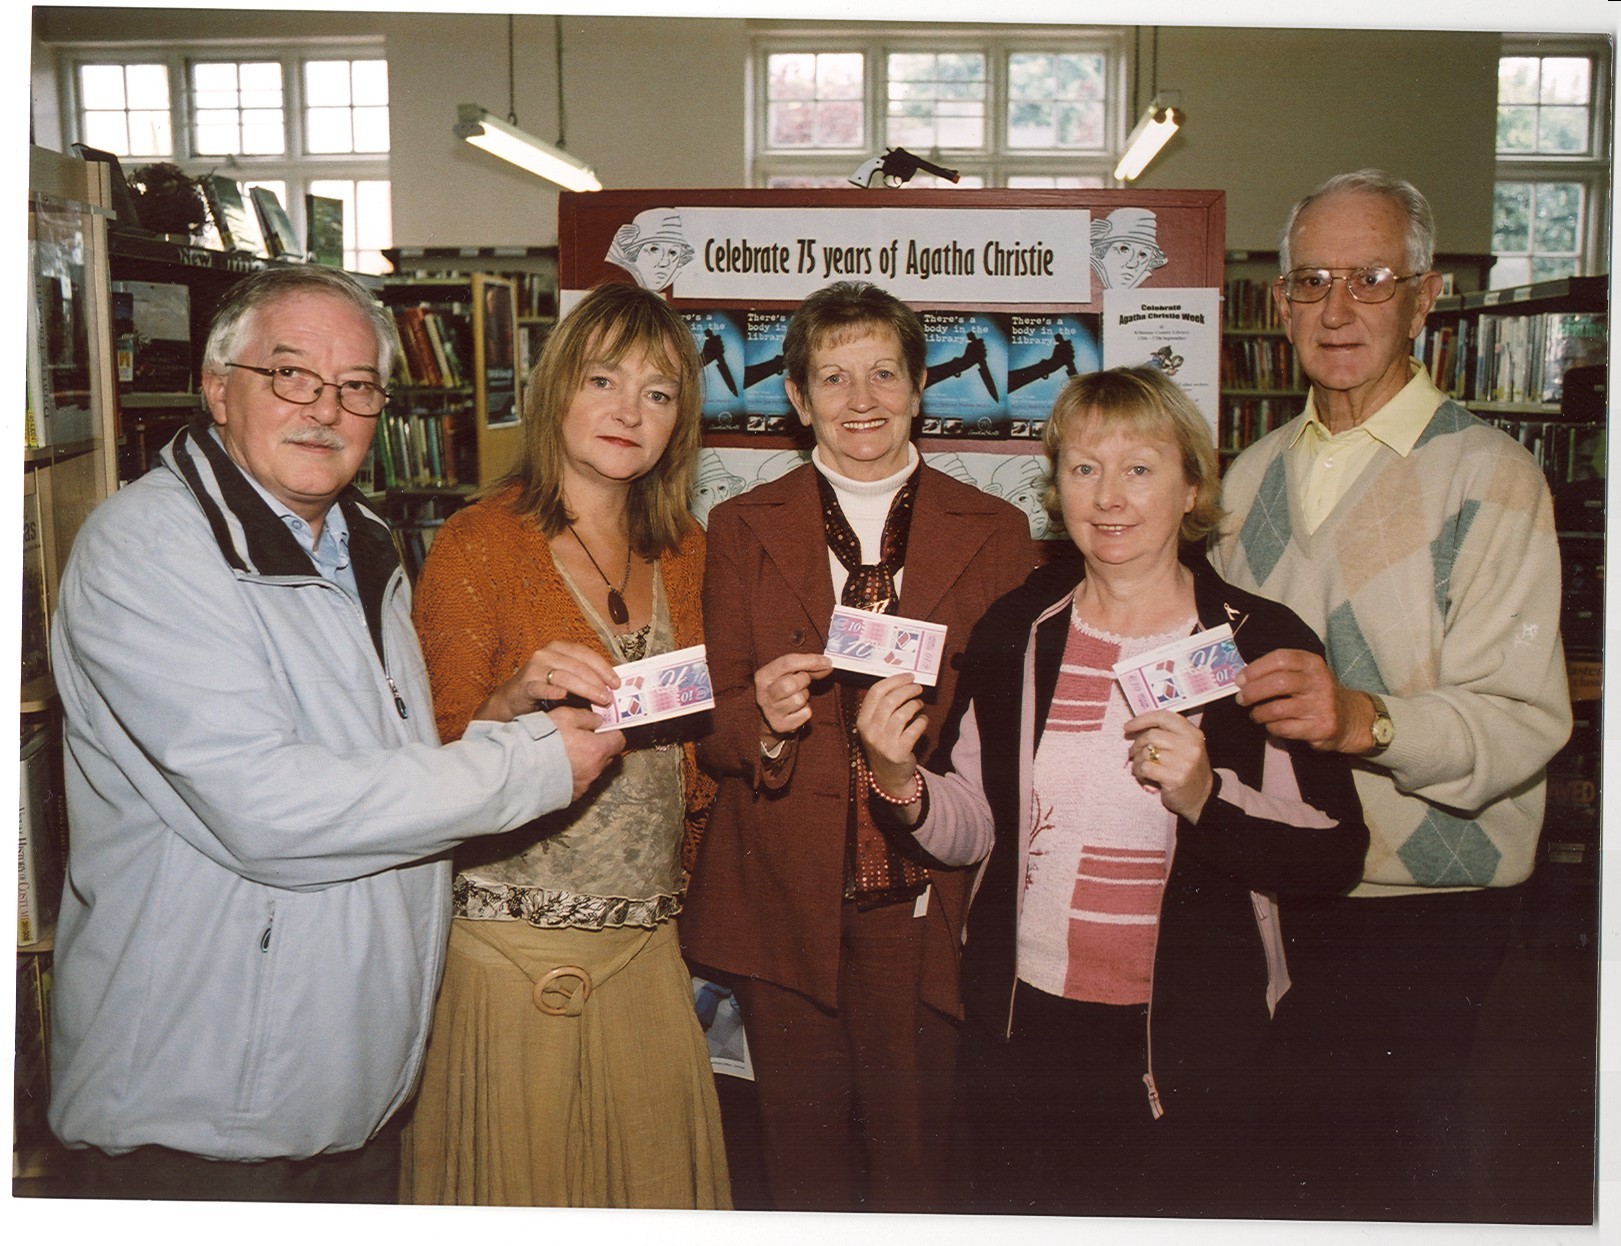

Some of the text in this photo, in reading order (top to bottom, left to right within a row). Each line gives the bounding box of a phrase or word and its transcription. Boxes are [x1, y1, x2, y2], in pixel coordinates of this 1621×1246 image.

[704, 238, 1055, 280] Celebrate 75 years of Agatha Christie
[748, 313, 786, 322] There's
[923, 314, 976, 324] There's a
[1011, 316, 1064, 326] There's a
[1119, 313, 1146, 325] Agatha
[1181, 312, 1205, 324] Week
[747, 323, 771, 333] body
[924, 324, 989, 335] body in the
[1012, 326, 1077, 336] body in the
[848, 621, 861, 632] 10
[1215, 670, 1229, 682] 10
[680, 690, 693, 703] 10
